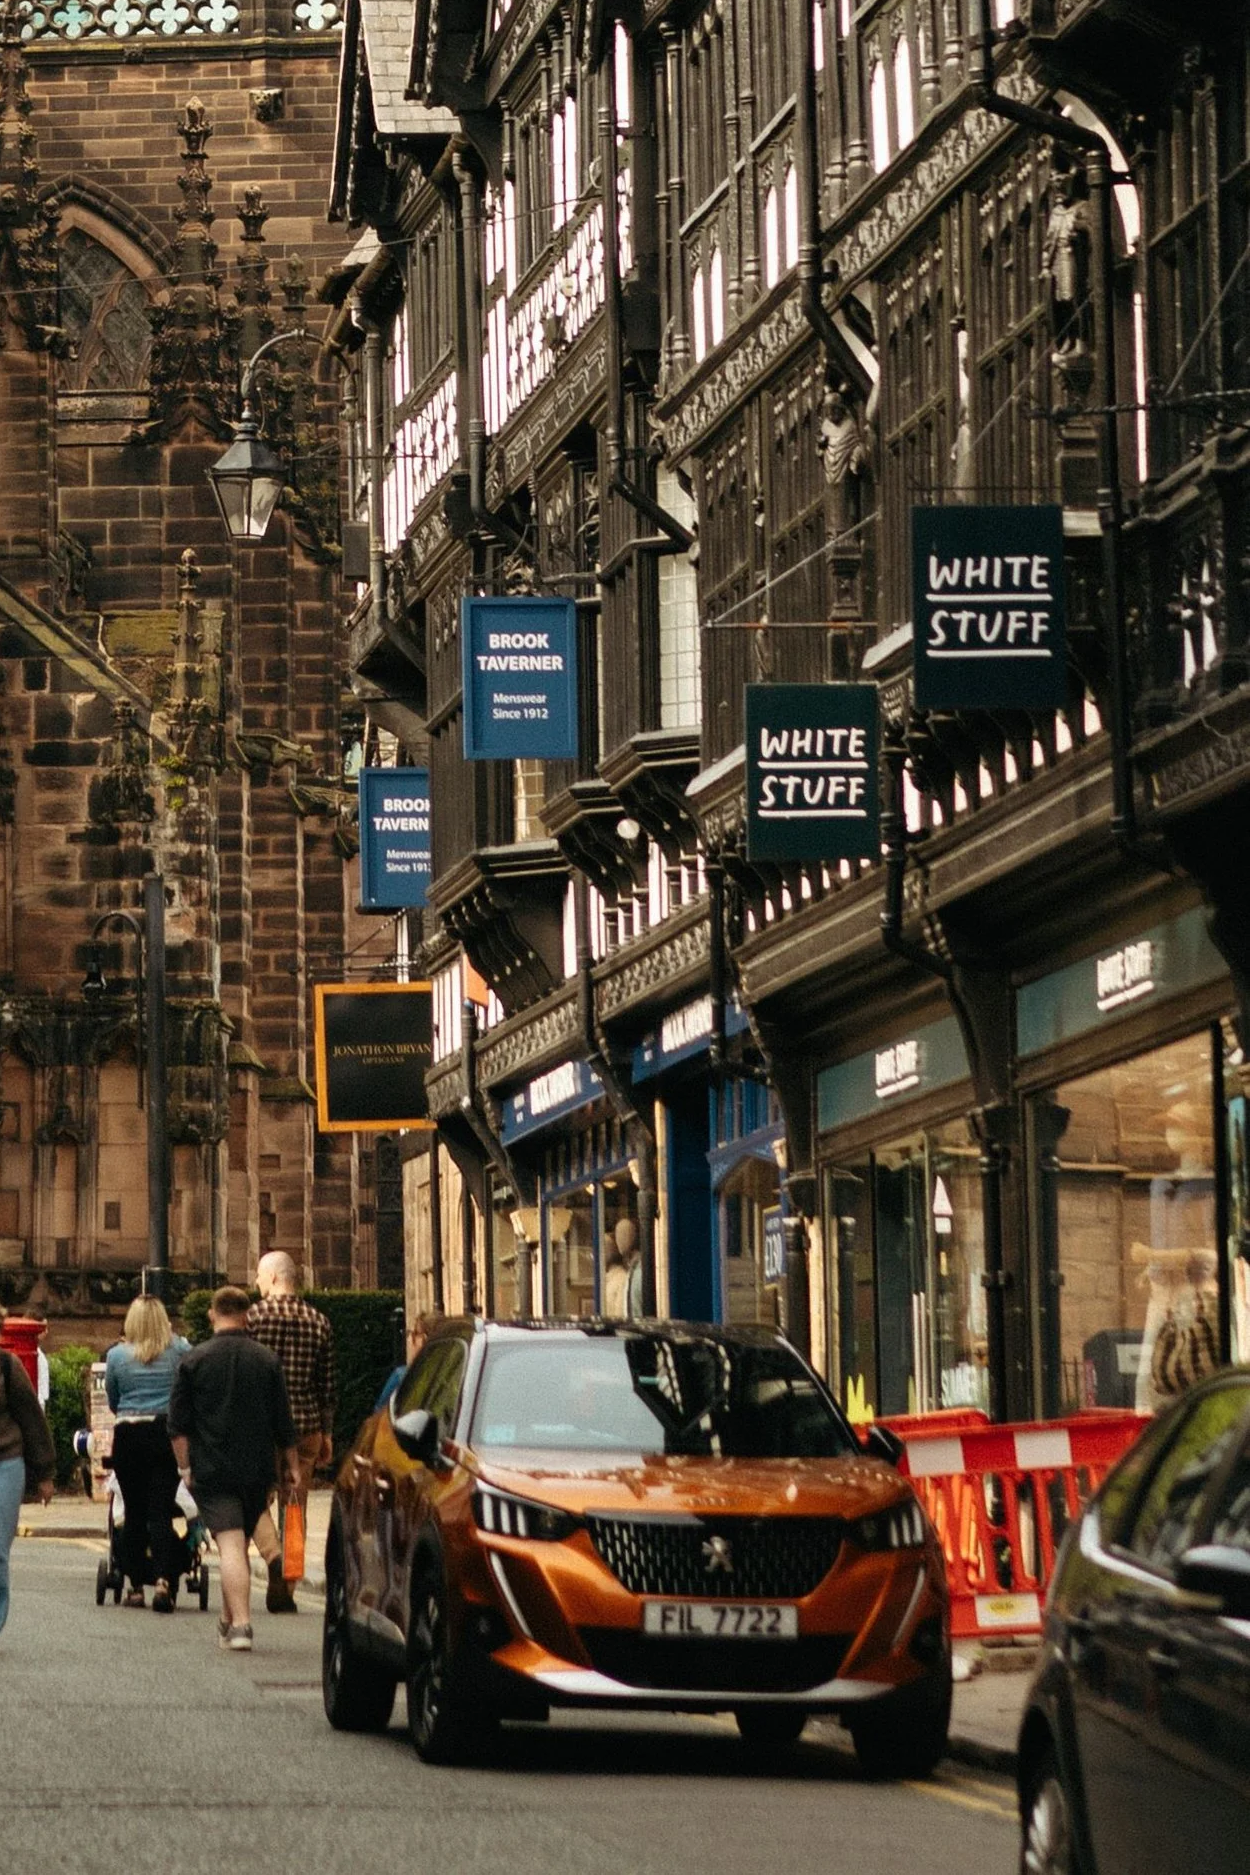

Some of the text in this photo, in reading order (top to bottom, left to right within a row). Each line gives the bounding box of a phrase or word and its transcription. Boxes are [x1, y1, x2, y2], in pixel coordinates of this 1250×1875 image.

[928, 554, 1051, 590] WHITE
[927, 610, 1050, 647] STUFF
[488, 633, 550, 649] BROOK
[476, 655, 564, 671] TAVERNER
[492, 692, 548, 704] Menswear
[492, 708, 549, 720] Since 1912
[759, 727, 867, 759] WHITE
[759, 775, 866, 808] STUFF
[385, 863, 411, 873] Since
[332, 1044, 395, 1057] JONATHON
[660, 1605, 782, 1634] FIL 7722
